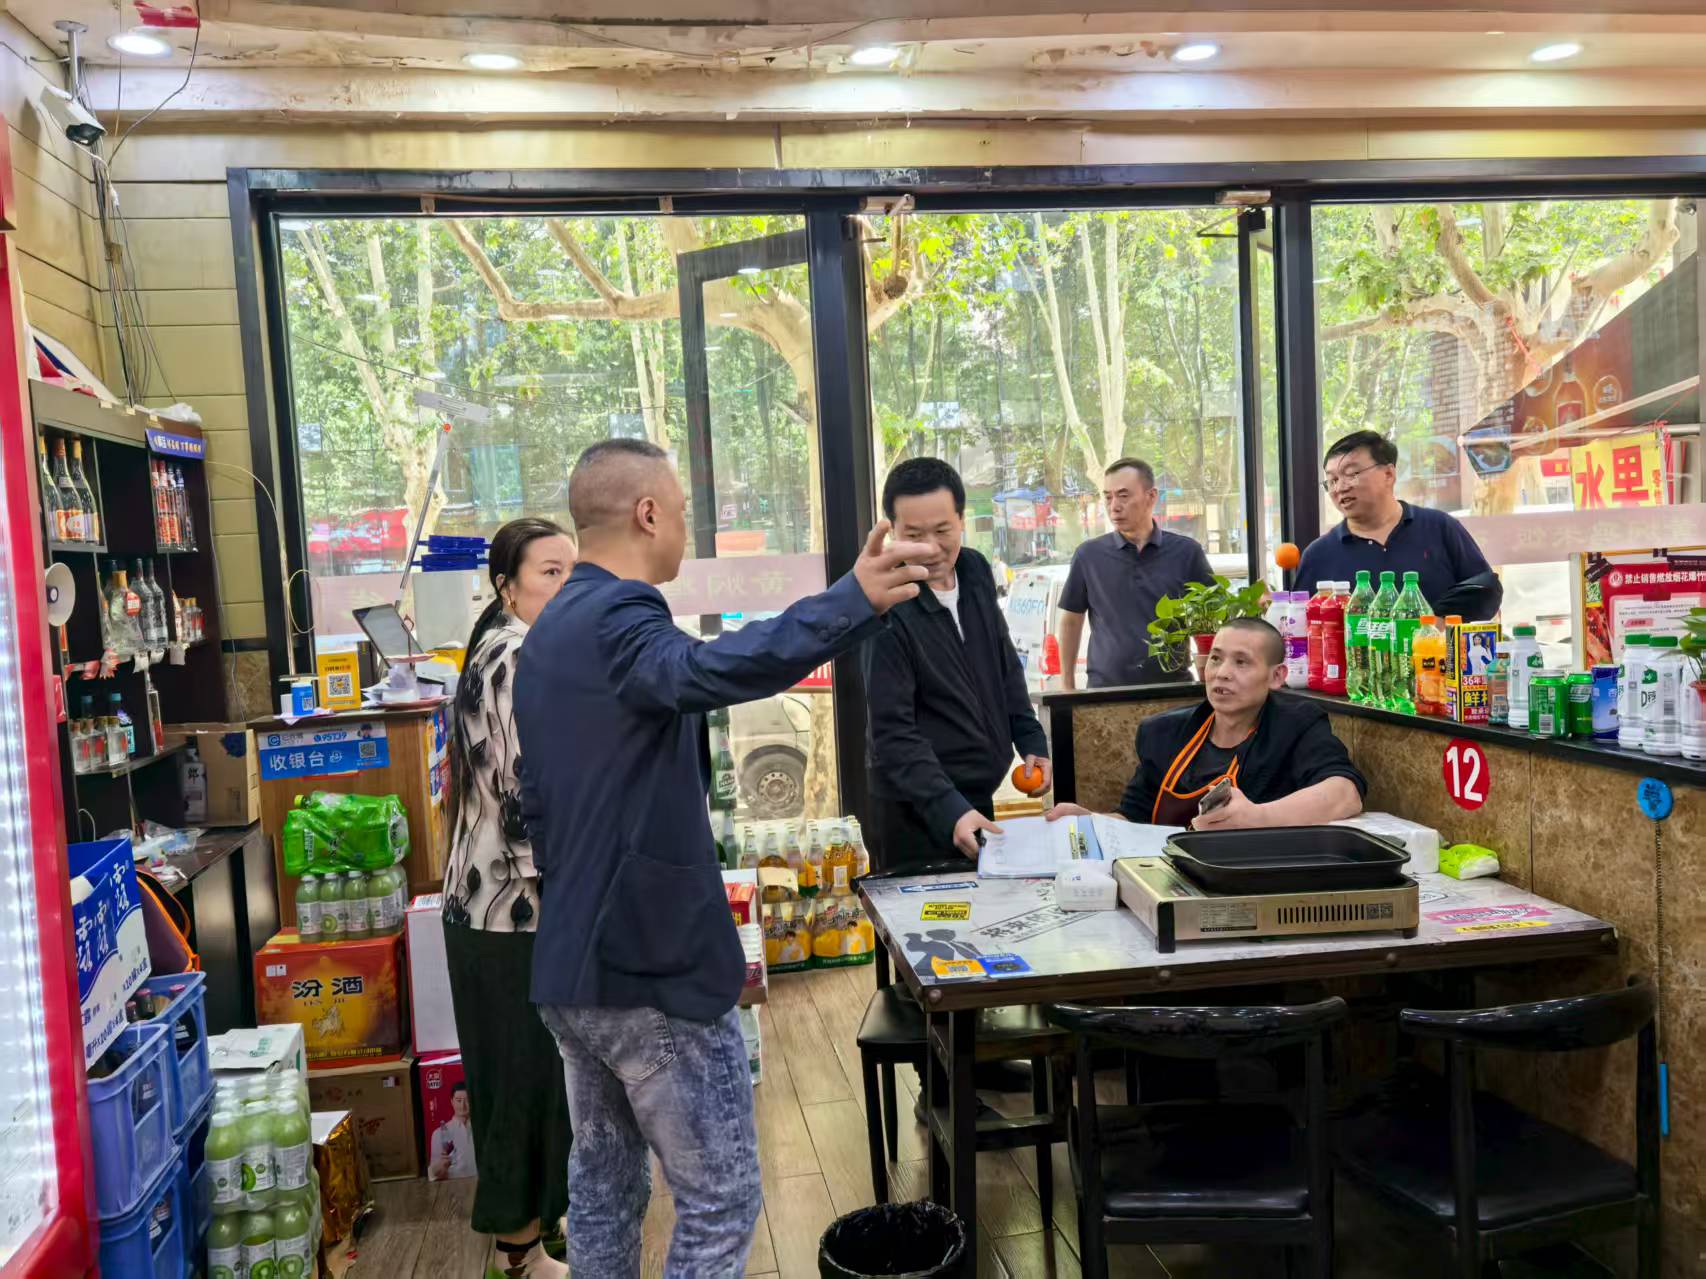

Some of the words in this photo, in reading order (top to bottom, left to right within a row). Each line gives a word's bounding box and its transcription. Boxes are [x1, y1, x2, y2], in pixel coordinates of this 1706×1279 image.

[269, 750, 325, 771] 收银台
[1446, 746, 1483, 802] 12
[291, 976, 363, 999] 汾酒
